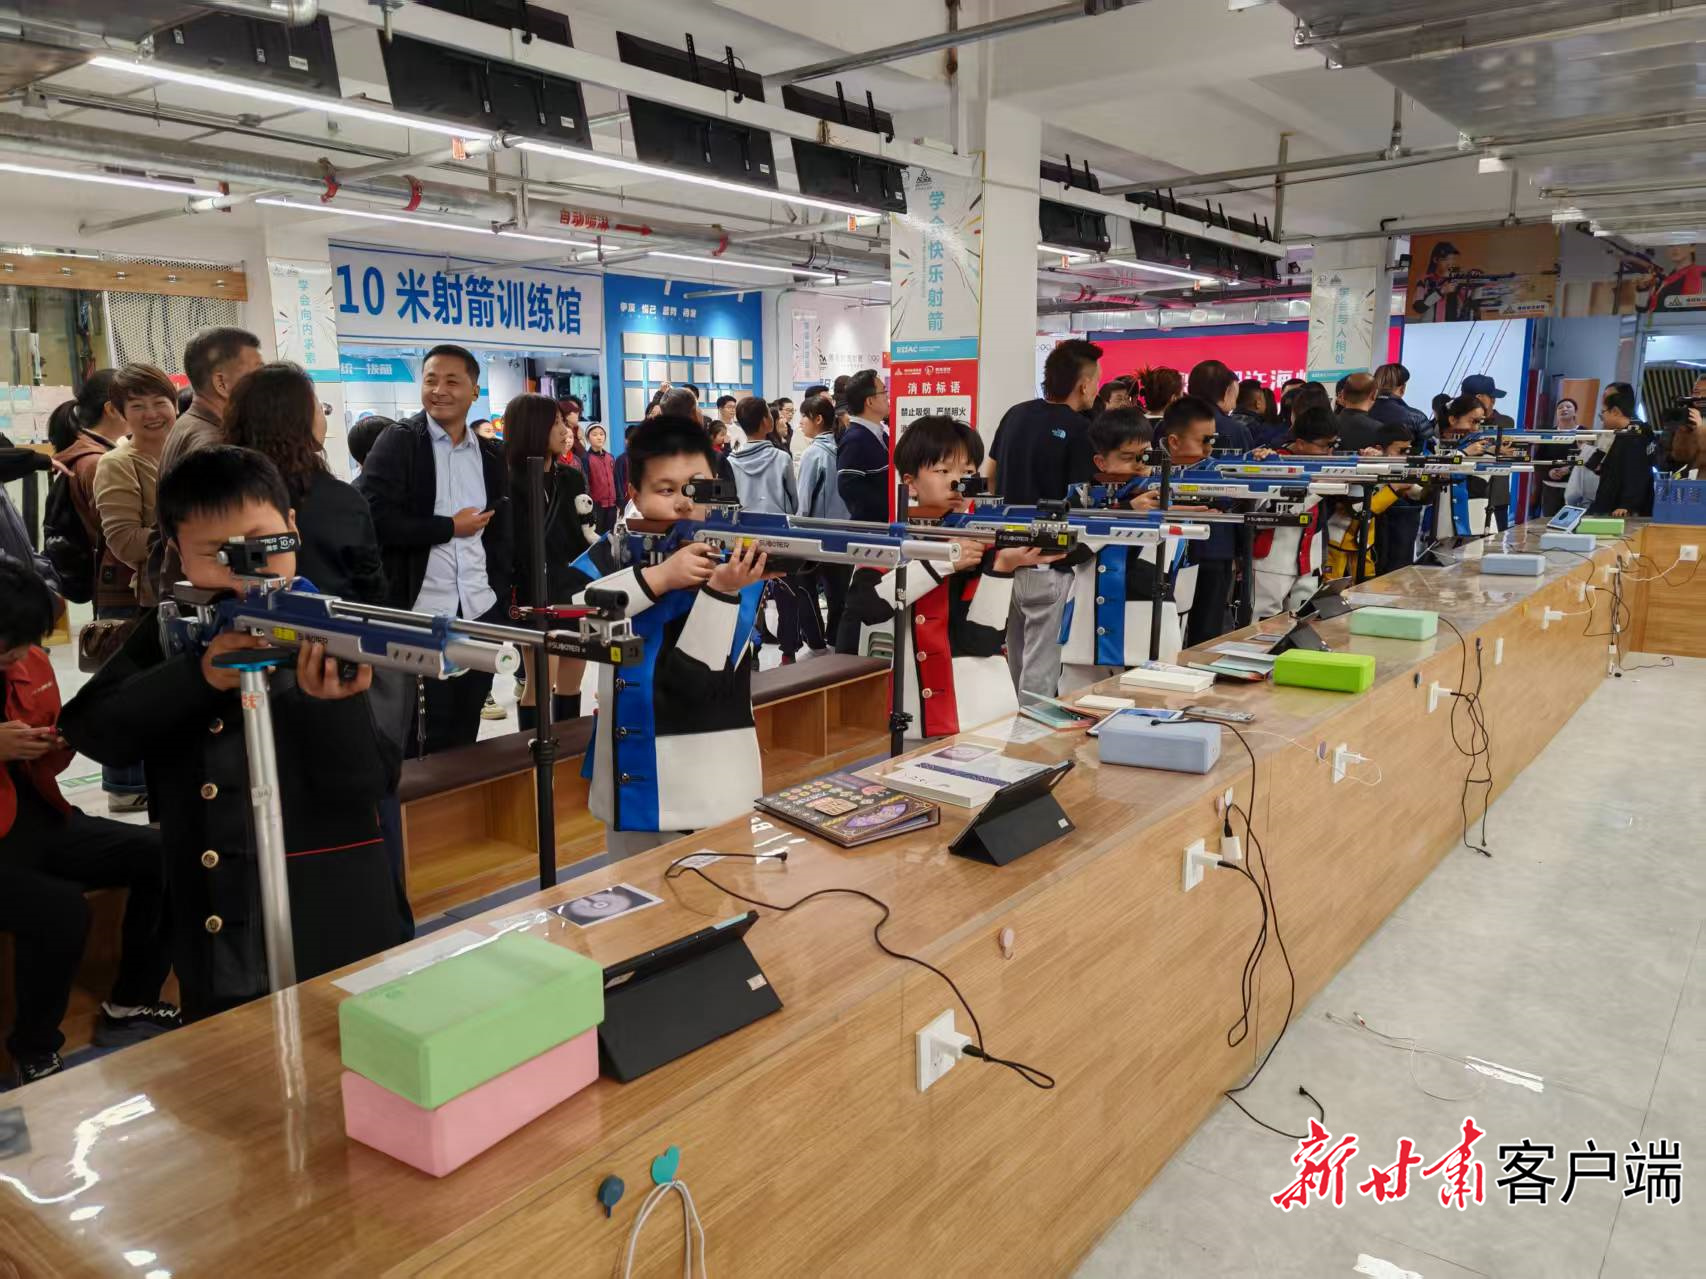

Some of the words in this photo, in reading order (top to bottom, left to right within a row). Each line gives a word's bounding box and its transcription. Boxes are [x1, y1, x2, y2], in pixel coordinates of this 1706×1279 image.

[927, 190, 945, 332] 学会快乐射箭
[336, 264, 385, 316] 10
[395, 268, 582, 336] 米射箭训练馆
[1335, 287, 1351, 365] 与人相处
[901, 406, 931, 417] 禁止吸烟
[936, 406, 967, 417] 严禁明火
[907, 380, 961, 395] 消防标语
